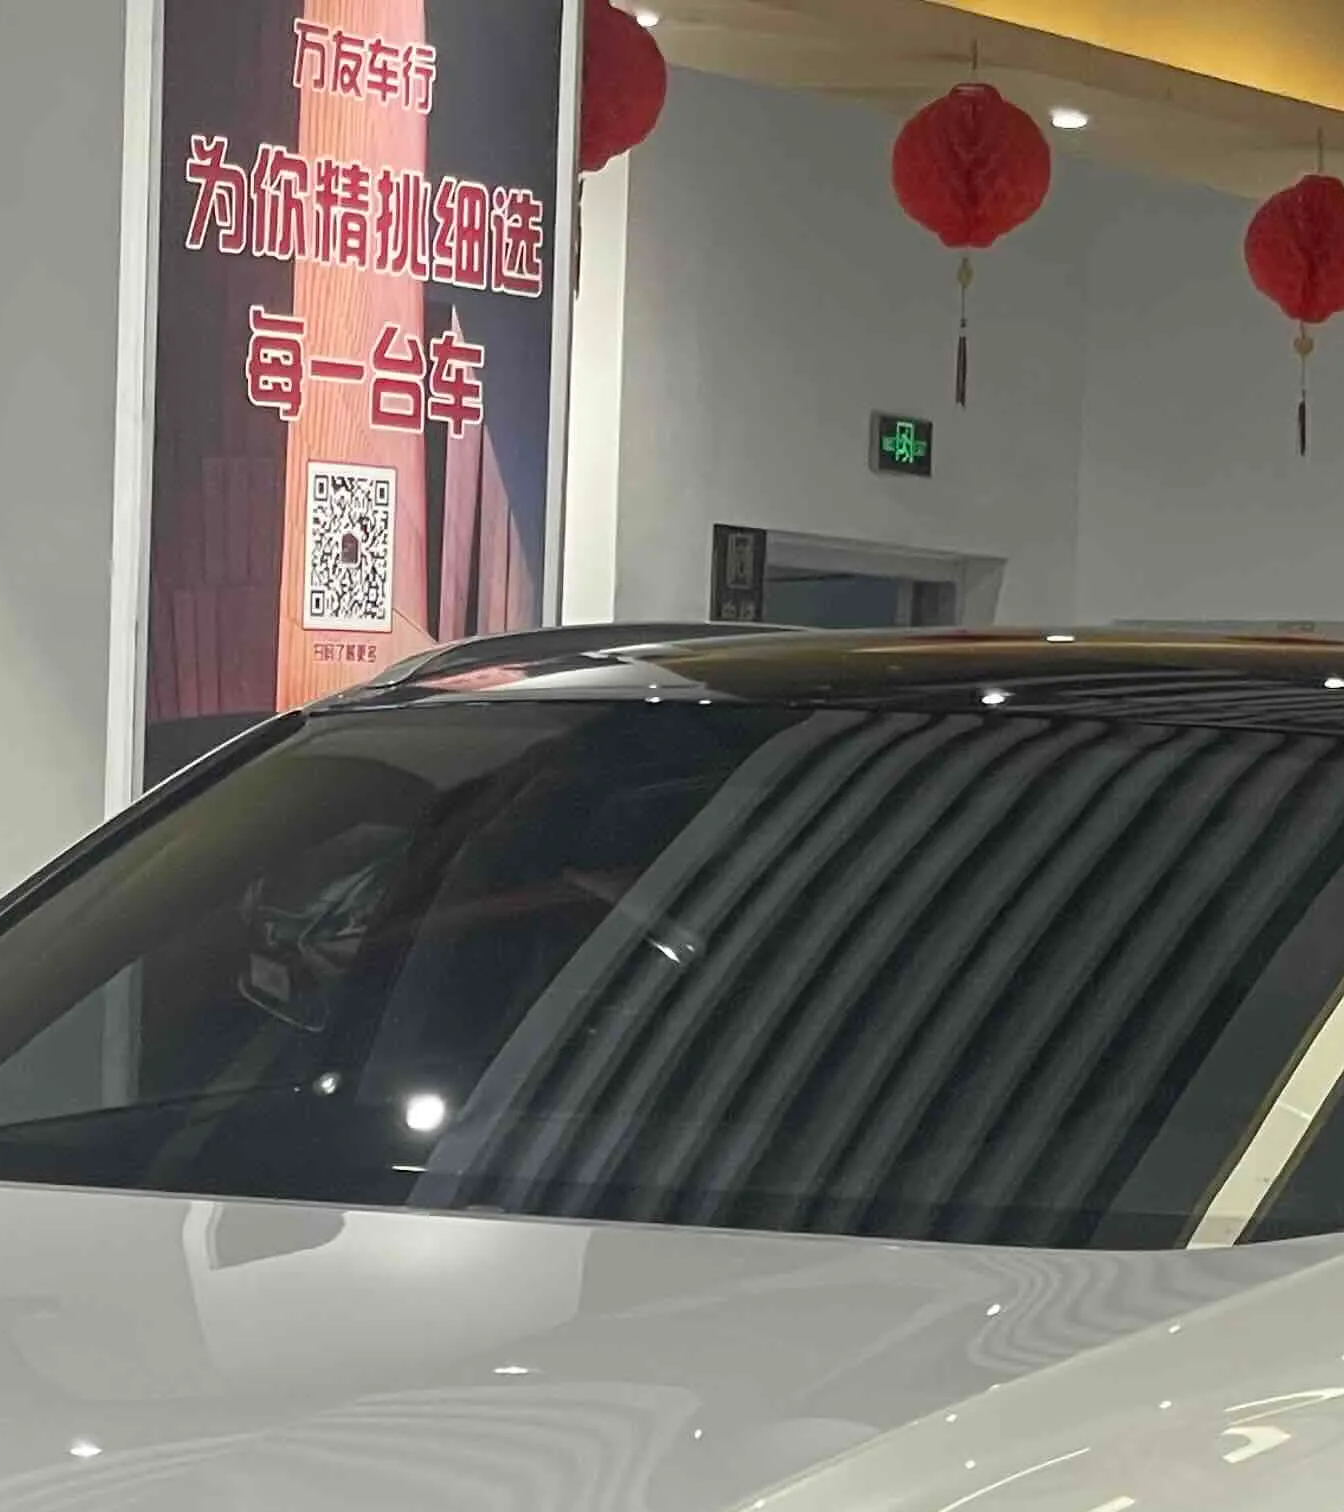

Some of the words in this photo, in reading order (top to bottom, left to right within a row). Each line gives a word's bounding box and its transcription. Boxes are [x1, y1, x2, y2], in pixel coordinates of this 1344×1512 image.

[293, 18, 437, 113] 万友车行
[186, 134, 543, 298] 为你精挑细选
[246, 305, 485, 439] 每一台车
